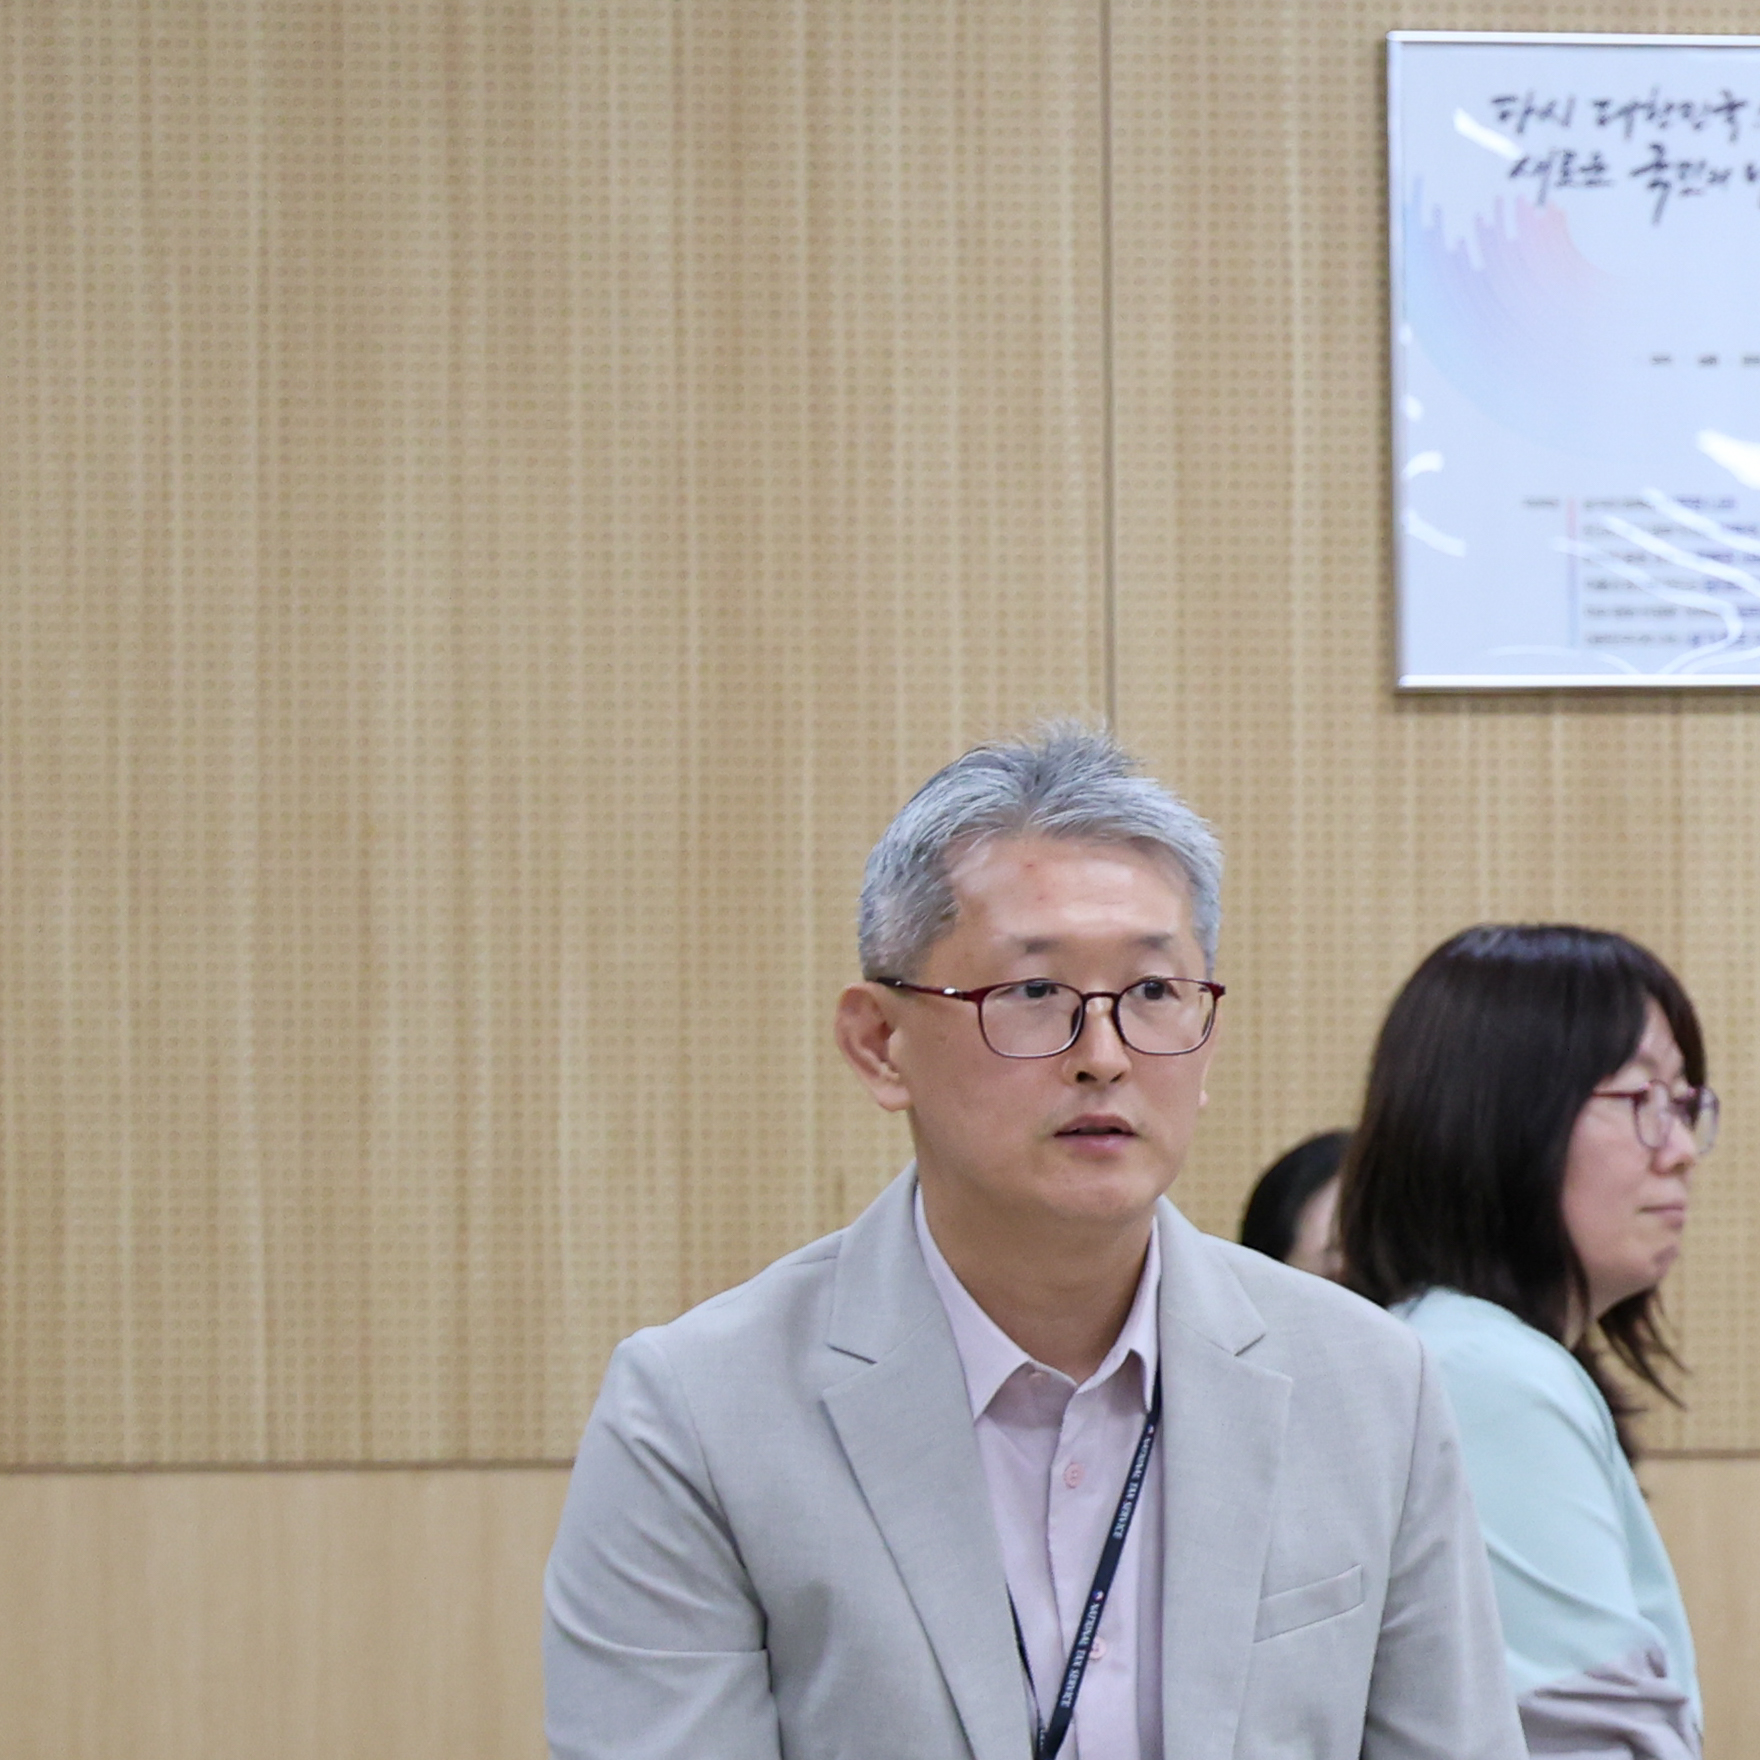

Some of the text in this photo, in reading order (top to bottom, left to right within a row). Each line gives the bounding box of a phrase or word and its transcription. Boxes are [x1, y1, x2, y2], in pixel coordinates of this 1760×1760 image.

[1488, 87, 1577, 136] 다시
[1508, 150, 1613, 207] 새로운
[1629, 142, 1734, 227] 국민의
